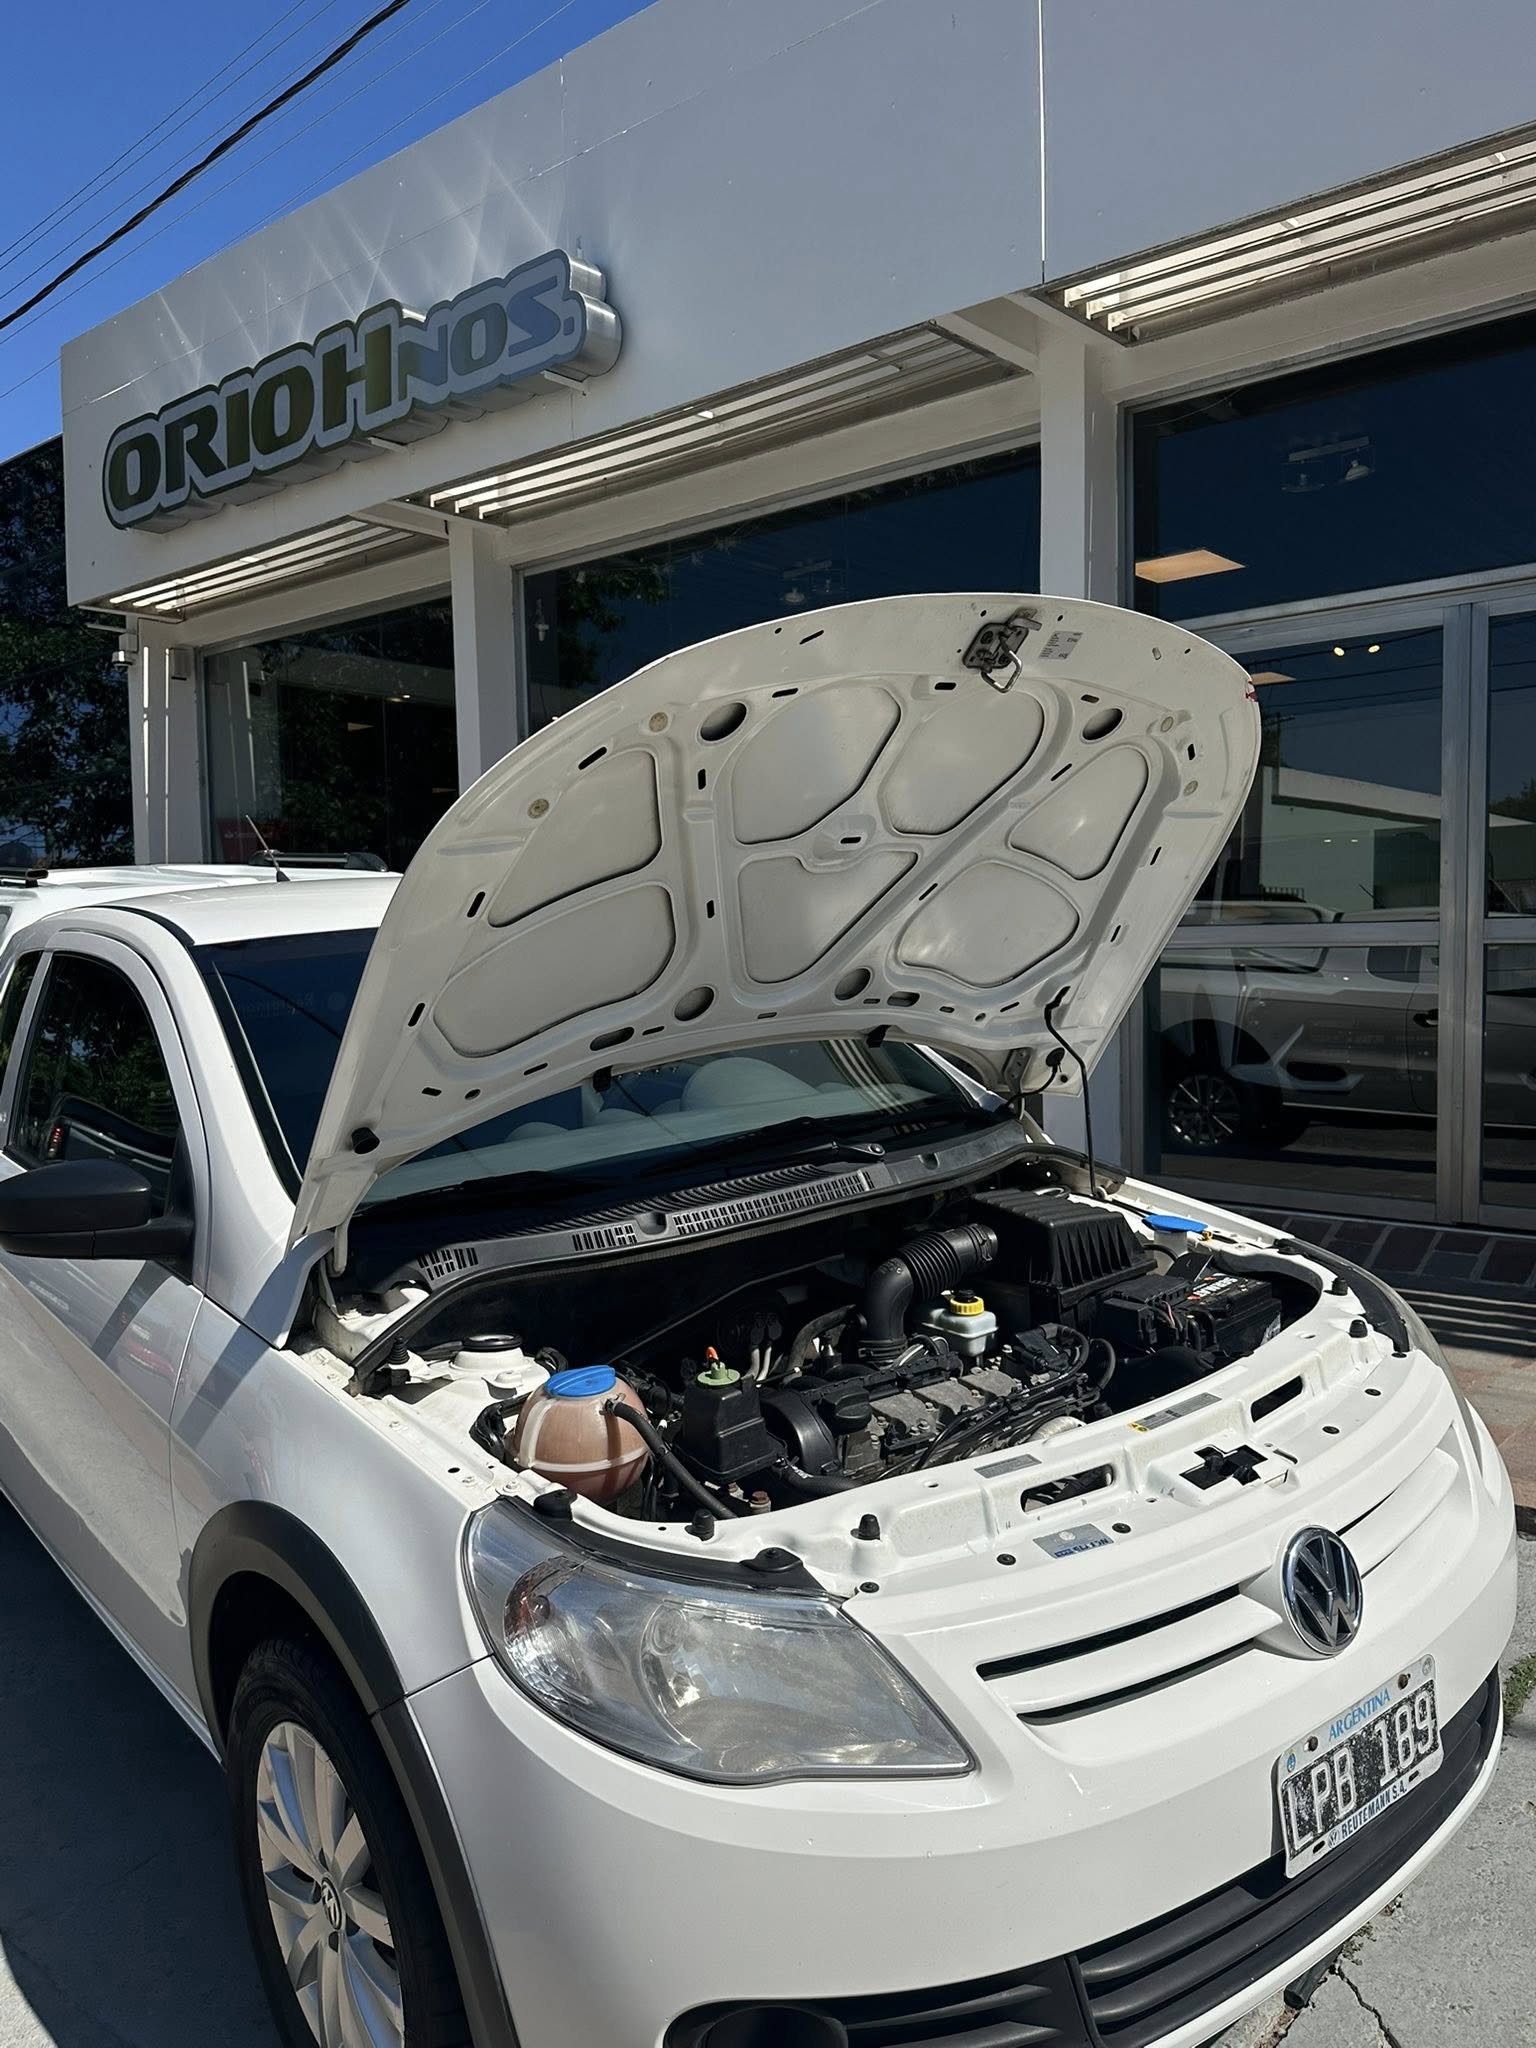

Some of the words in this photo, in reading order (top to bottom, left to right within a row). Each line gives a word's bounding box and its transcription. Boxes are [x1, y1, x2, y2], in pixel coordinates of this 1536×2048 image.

[1287, 1530, 1360, 1653] VW
[1328, 1688, 1391, 1742] ARGENTINA
[1286, 1747, 1357, 1852] LPB
[1374, 1690, 1435, 1788] 189
[1341, 1788, 1391, 1839] REUTEMANN
[1392, 1780, 1408, 1800] S.A.
